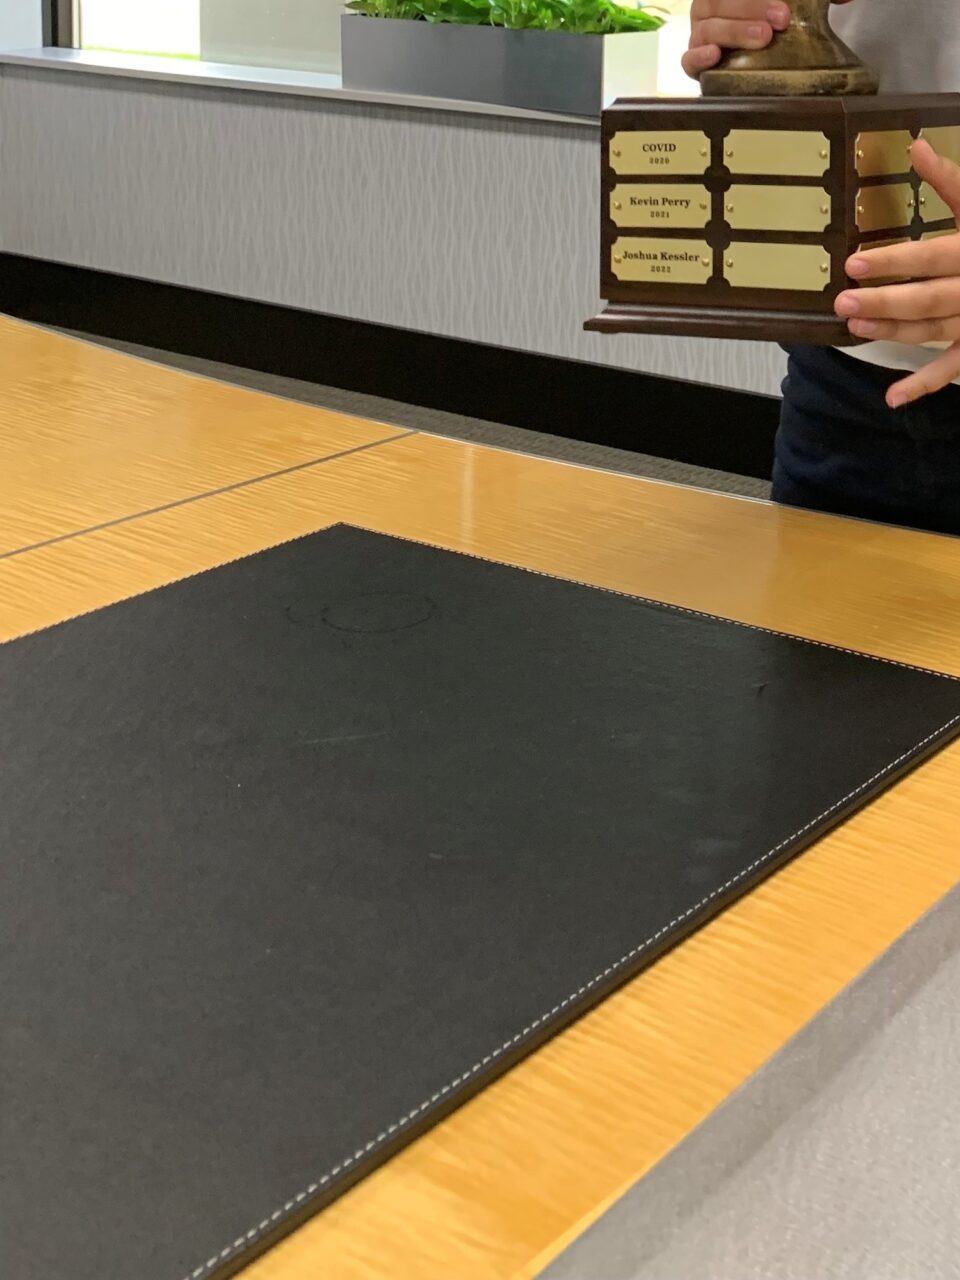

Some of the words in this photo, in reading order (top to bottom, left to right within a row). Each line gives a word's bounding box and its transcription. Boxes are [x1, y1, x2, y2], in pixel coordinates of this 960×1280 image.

[642, 143, 677, 153] COVID
[649, 157, 670, 165] 2020
[629, 196, 659, 206] Kevin
[661, 197, 691, 208] Perry
[622, 250, 658, 261] Joshua
[660, 252, 700, 262] Kessler
[650, 265, 671, 273] 2022
